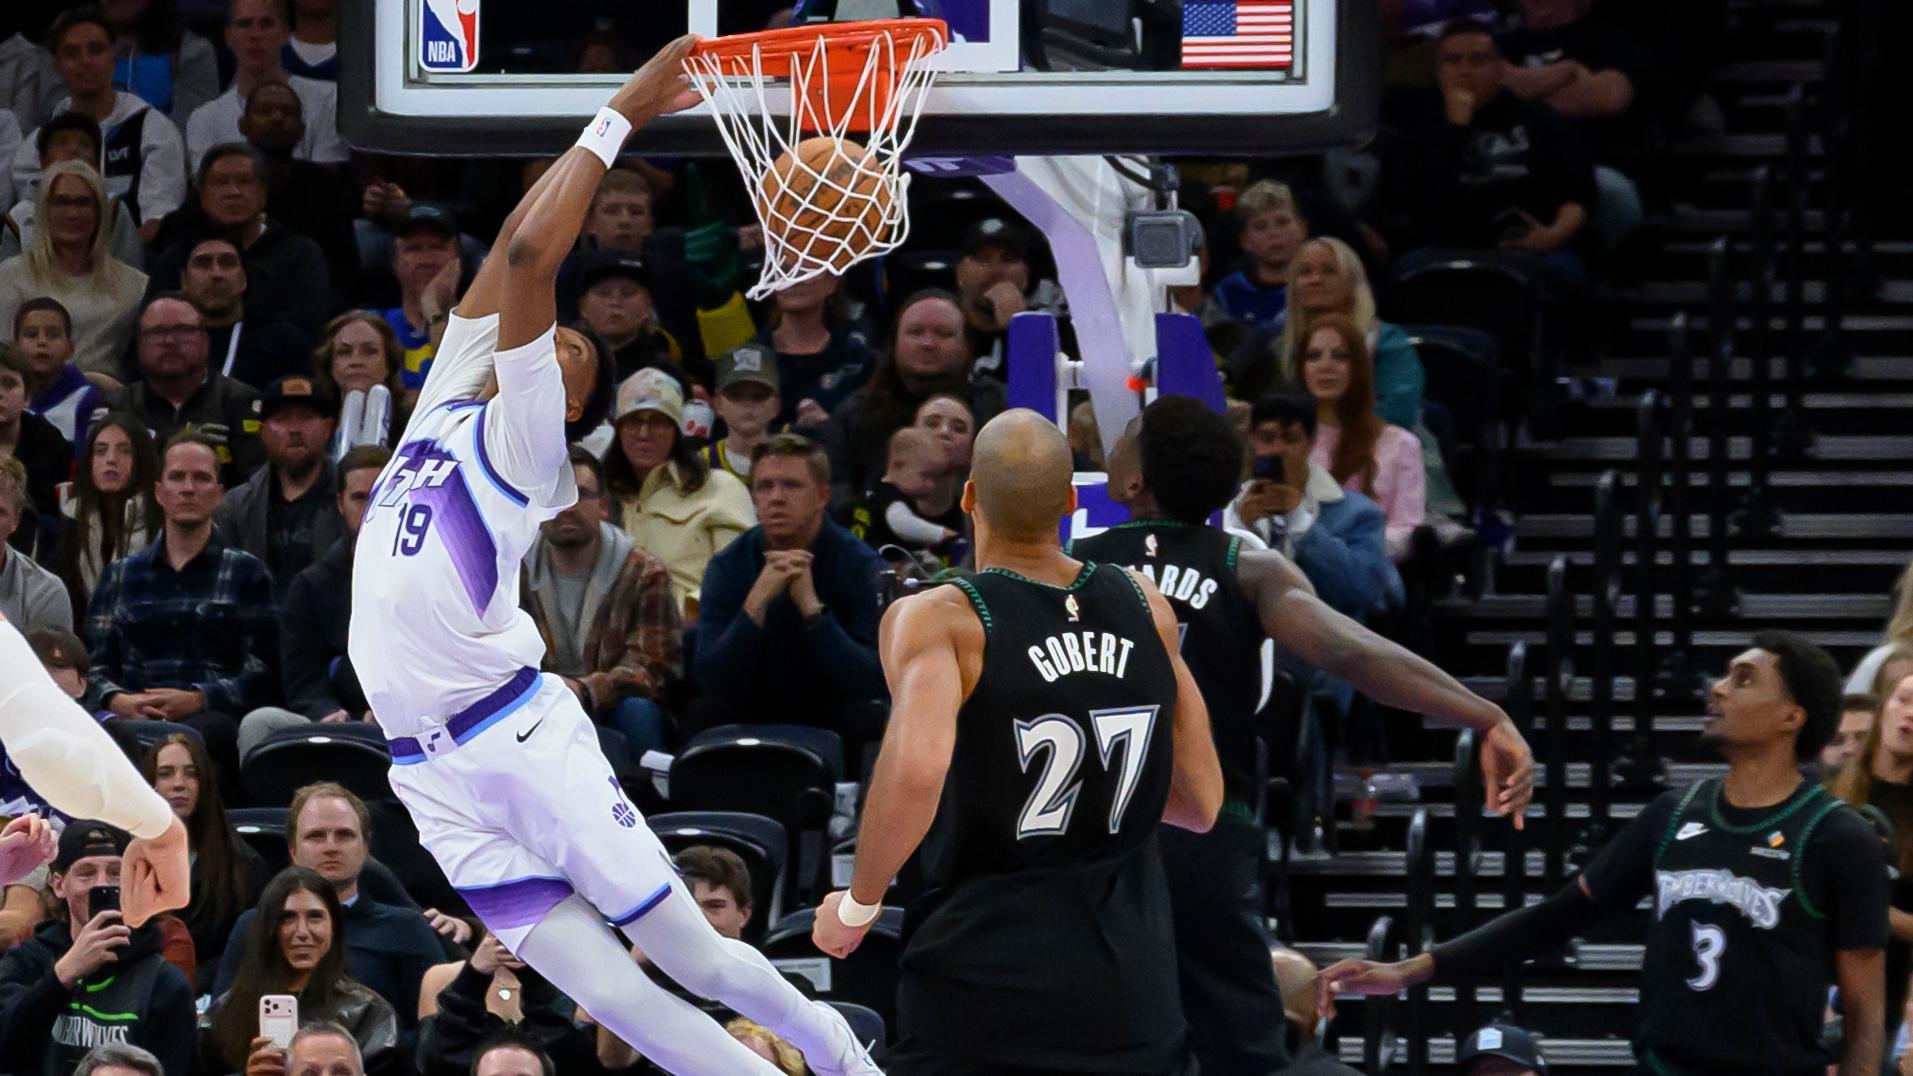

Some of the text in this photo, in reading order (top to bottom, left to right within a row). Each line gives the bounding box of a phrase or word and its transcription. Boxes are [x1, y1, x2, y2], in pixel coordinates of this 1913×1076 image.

[428, 40, 457, 63] NBA
[391, 502, 433, 558] 19
[1027, 630, 1135, 683] GOBERT
[1012, 703, 1162, 841] 27
[1685, 918, 1728, 992] 3
